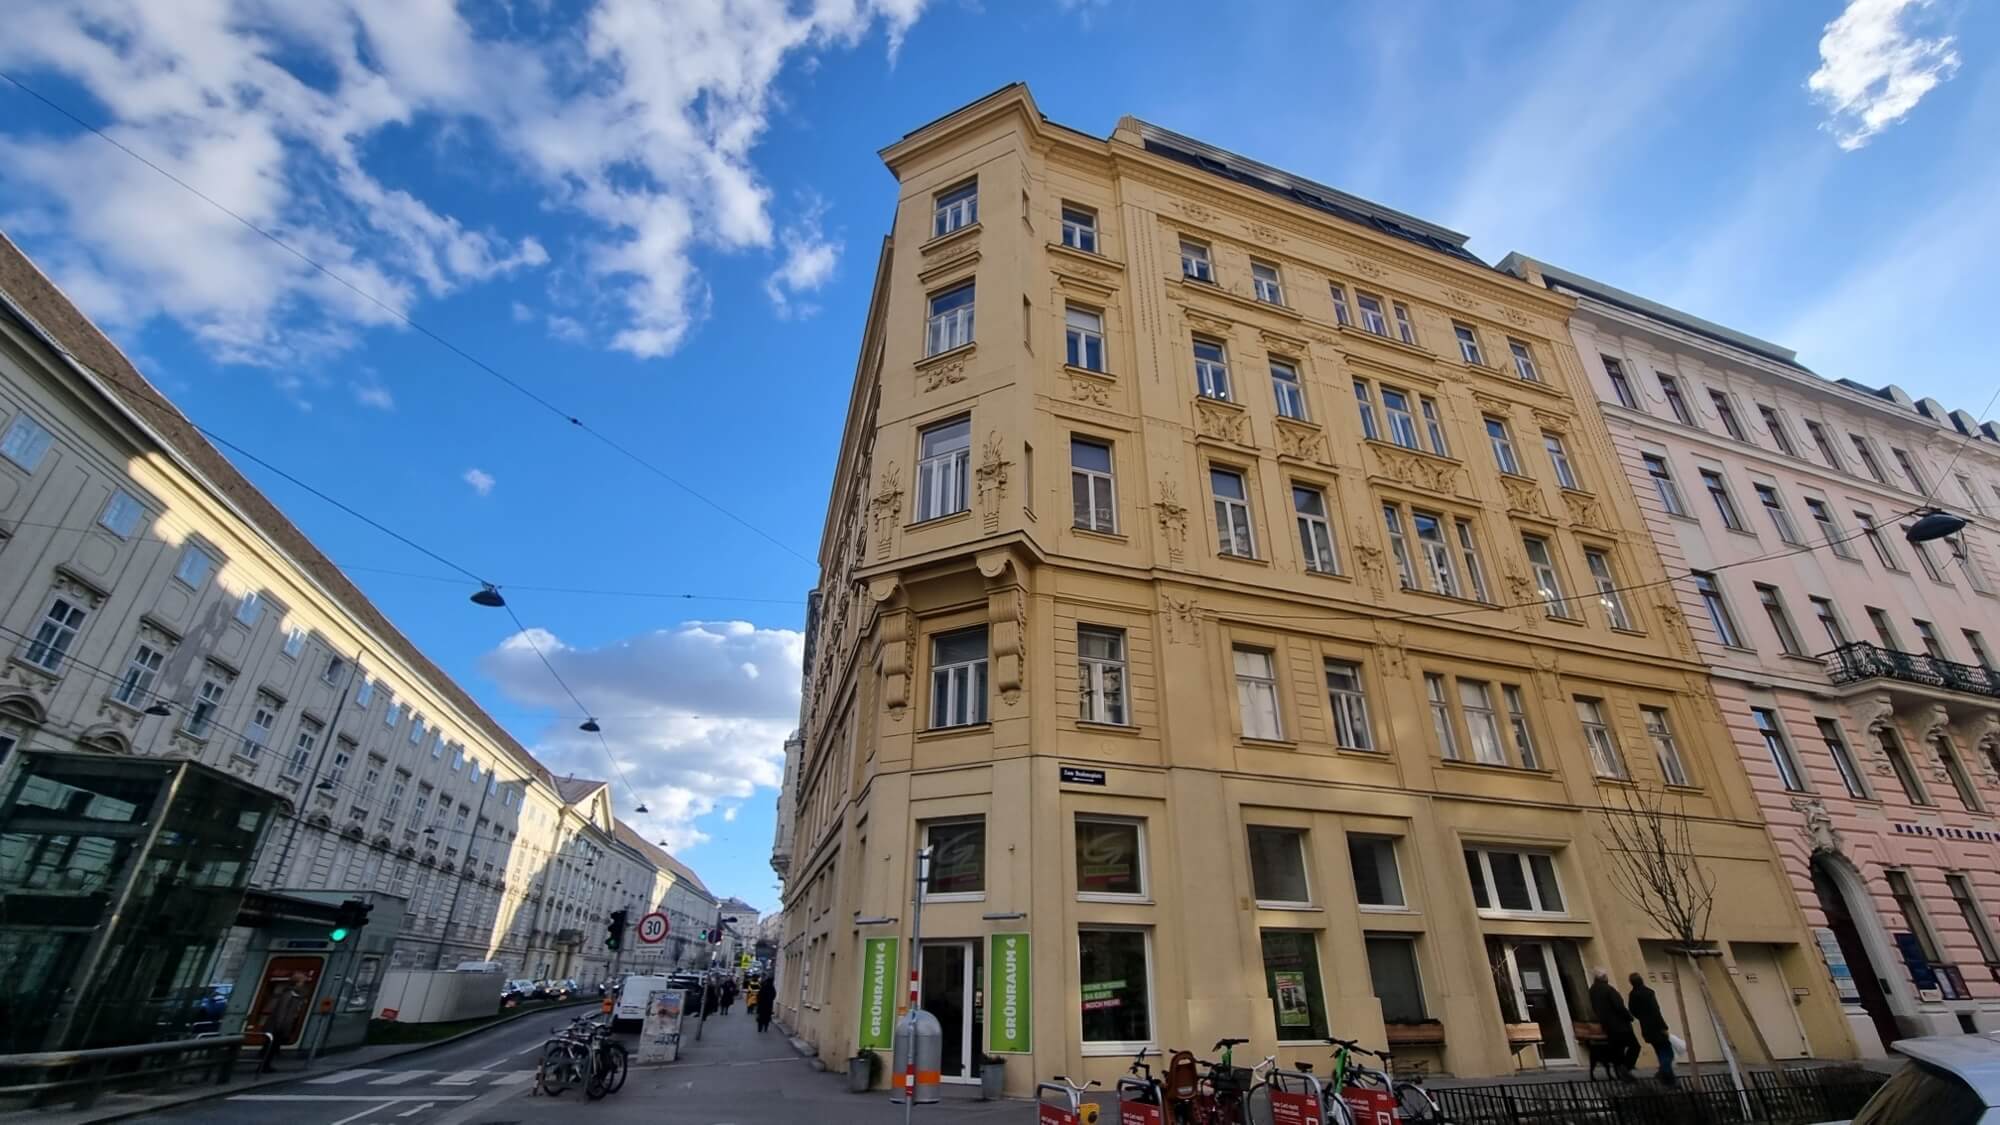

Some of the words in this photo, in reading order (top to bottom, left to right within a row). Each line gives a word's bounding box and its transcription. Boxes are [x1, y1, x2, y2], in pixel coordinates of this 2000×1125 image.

[1894, 823, 1933, 836] HAUS
[1936, 827, 1964, 839] DER
[645, 921, 661, 935] 30
[877, 943, 886, 952] 4
[1006, 938, 1016, 948] 4
[872, 953, 885, 1036] GRÜNRAUM
[1004, 950, 1016, 1040] GRÜNRAUM
